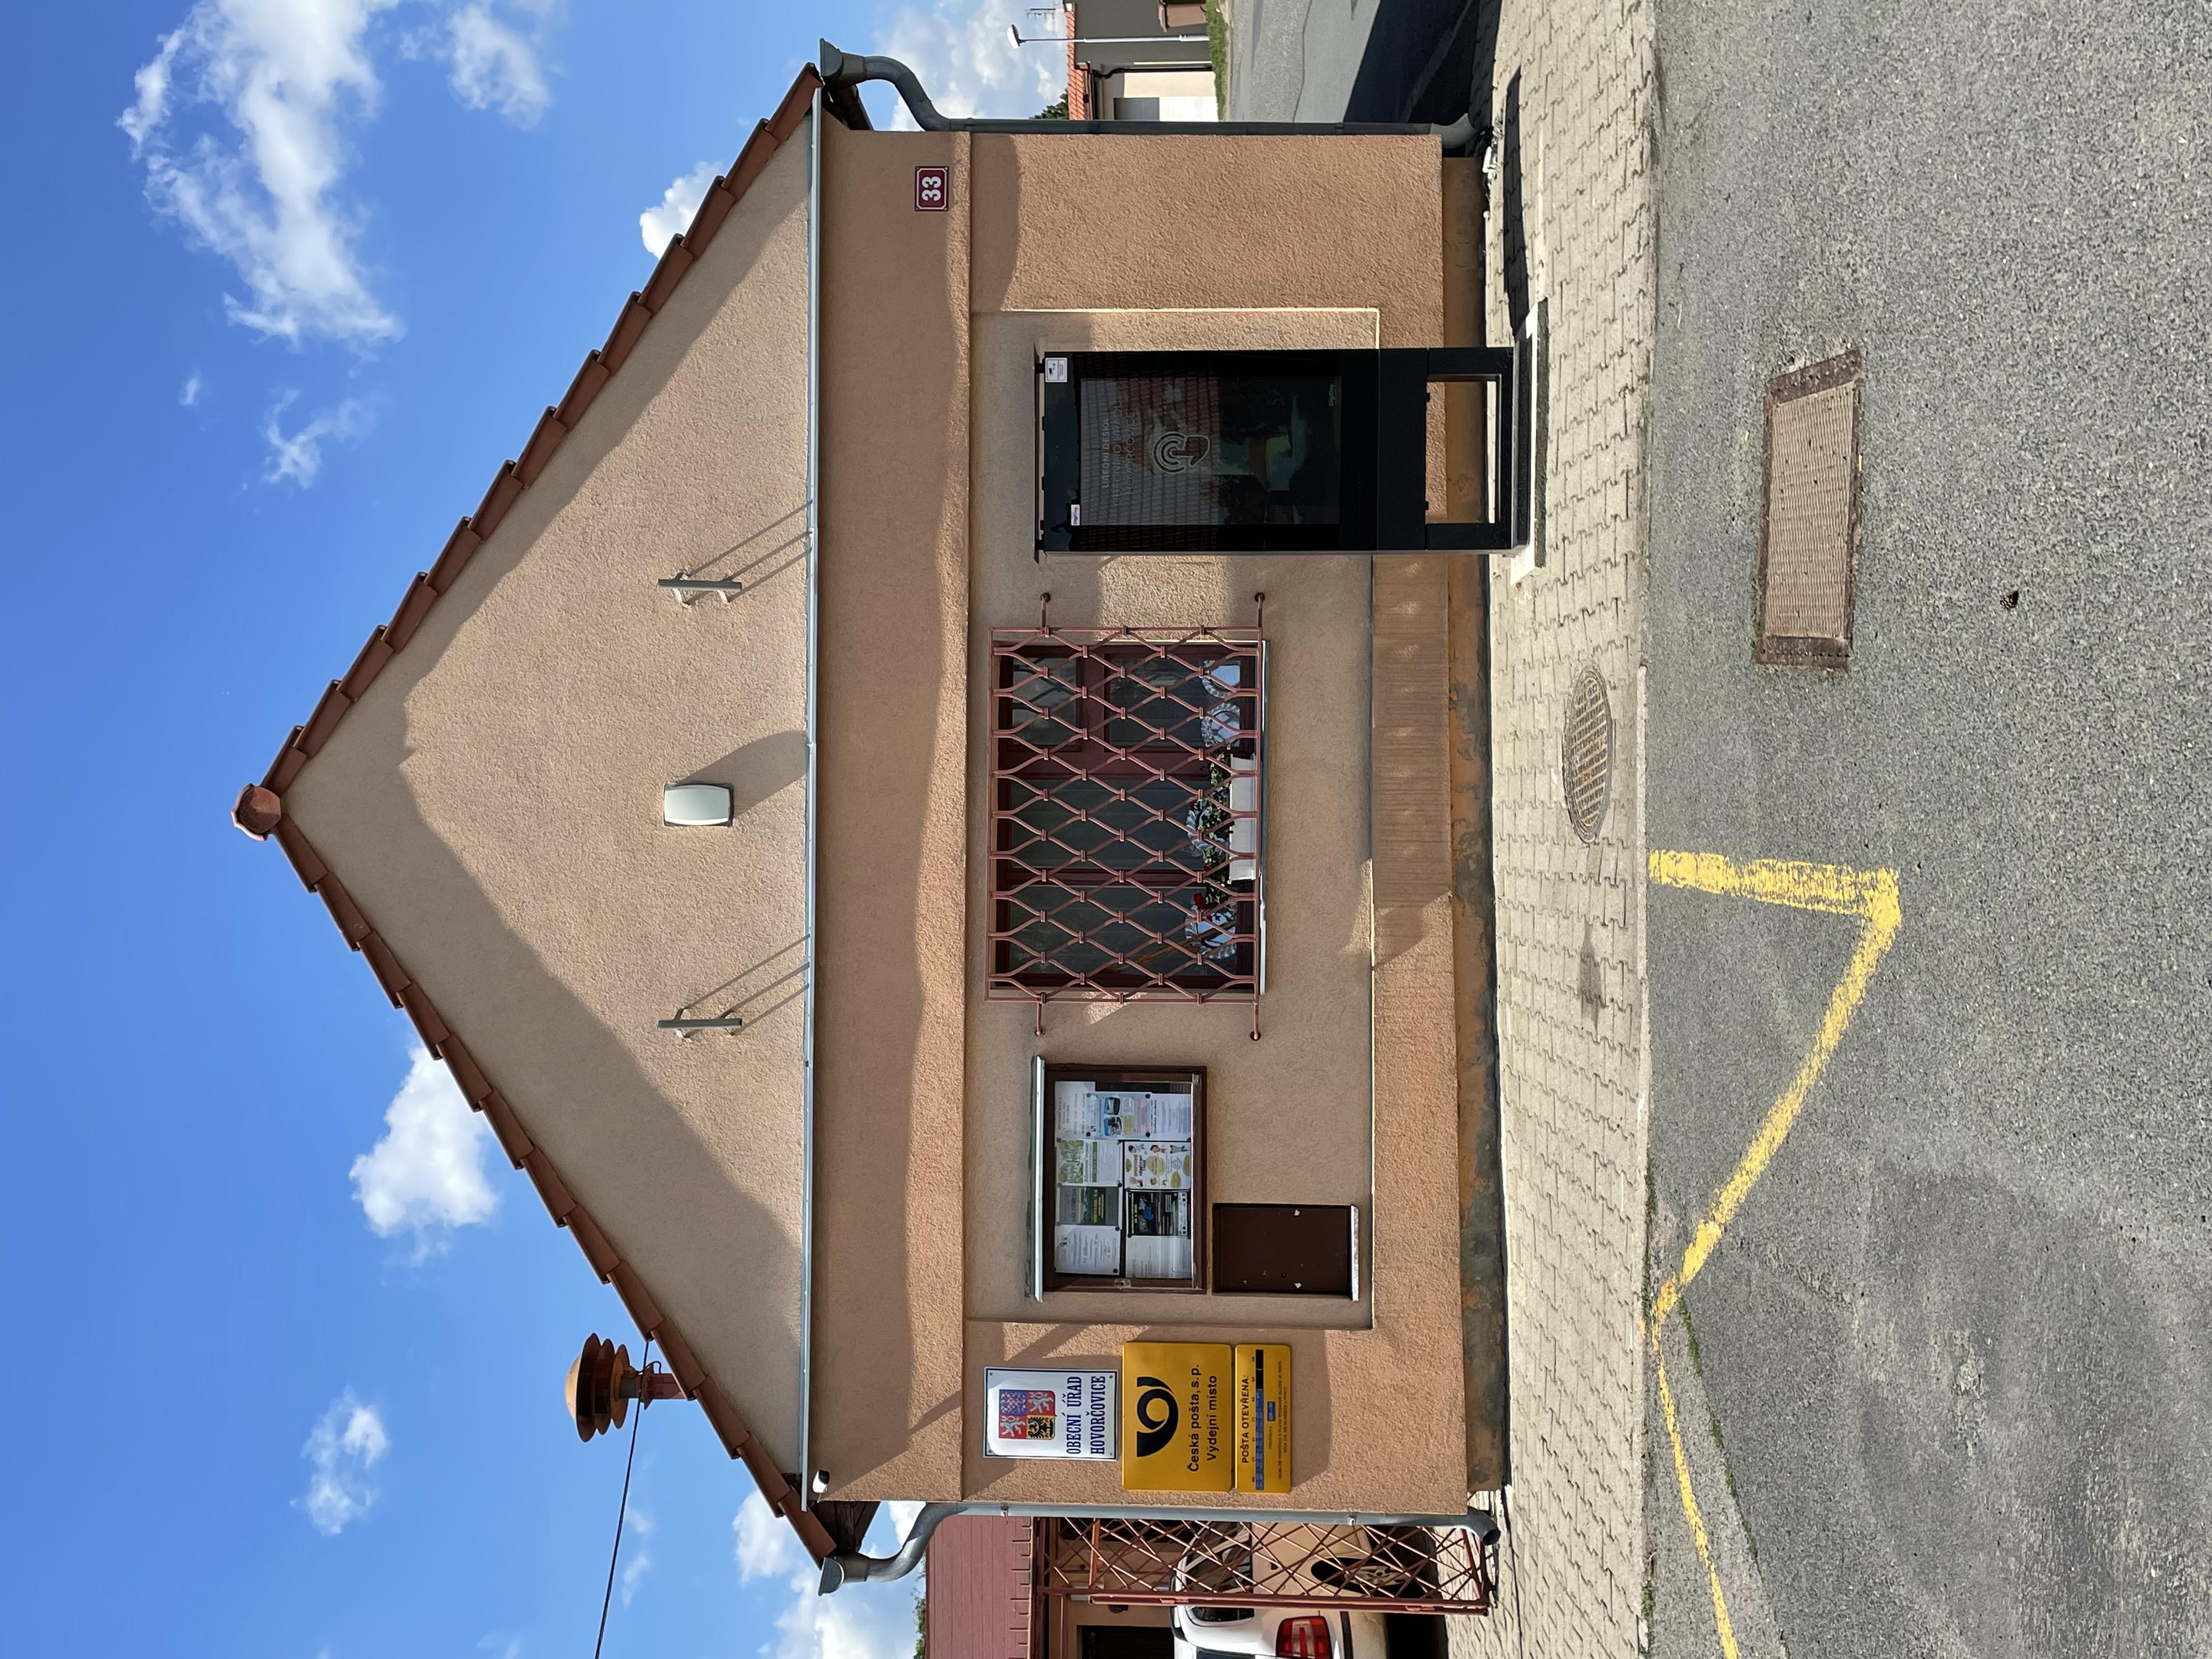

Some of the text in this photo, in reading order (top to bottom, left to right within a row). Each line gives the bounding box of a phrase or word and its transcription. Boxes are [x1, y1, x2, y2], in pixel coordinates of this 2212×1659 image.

[921, 176, 941, 201] 33
[1102, 419, 1110, 450] DESKA
[1124, 411, 1135, 494] HOVORČOVICE
[1061, 1376, 1082, 1454] OBECNÍ ÚŘAD
[1085, 1376, 1105, 1455] HOVORČOVICE
[1188, 1390, 1202, 1429] pošta,
[1206, 1375, 1219, 1461] Výdejní místo
[1240, 1375, 1249, 1463] POŠTA OTEVŘENA:
[1187, 1433, 1199, 1472] Česká
